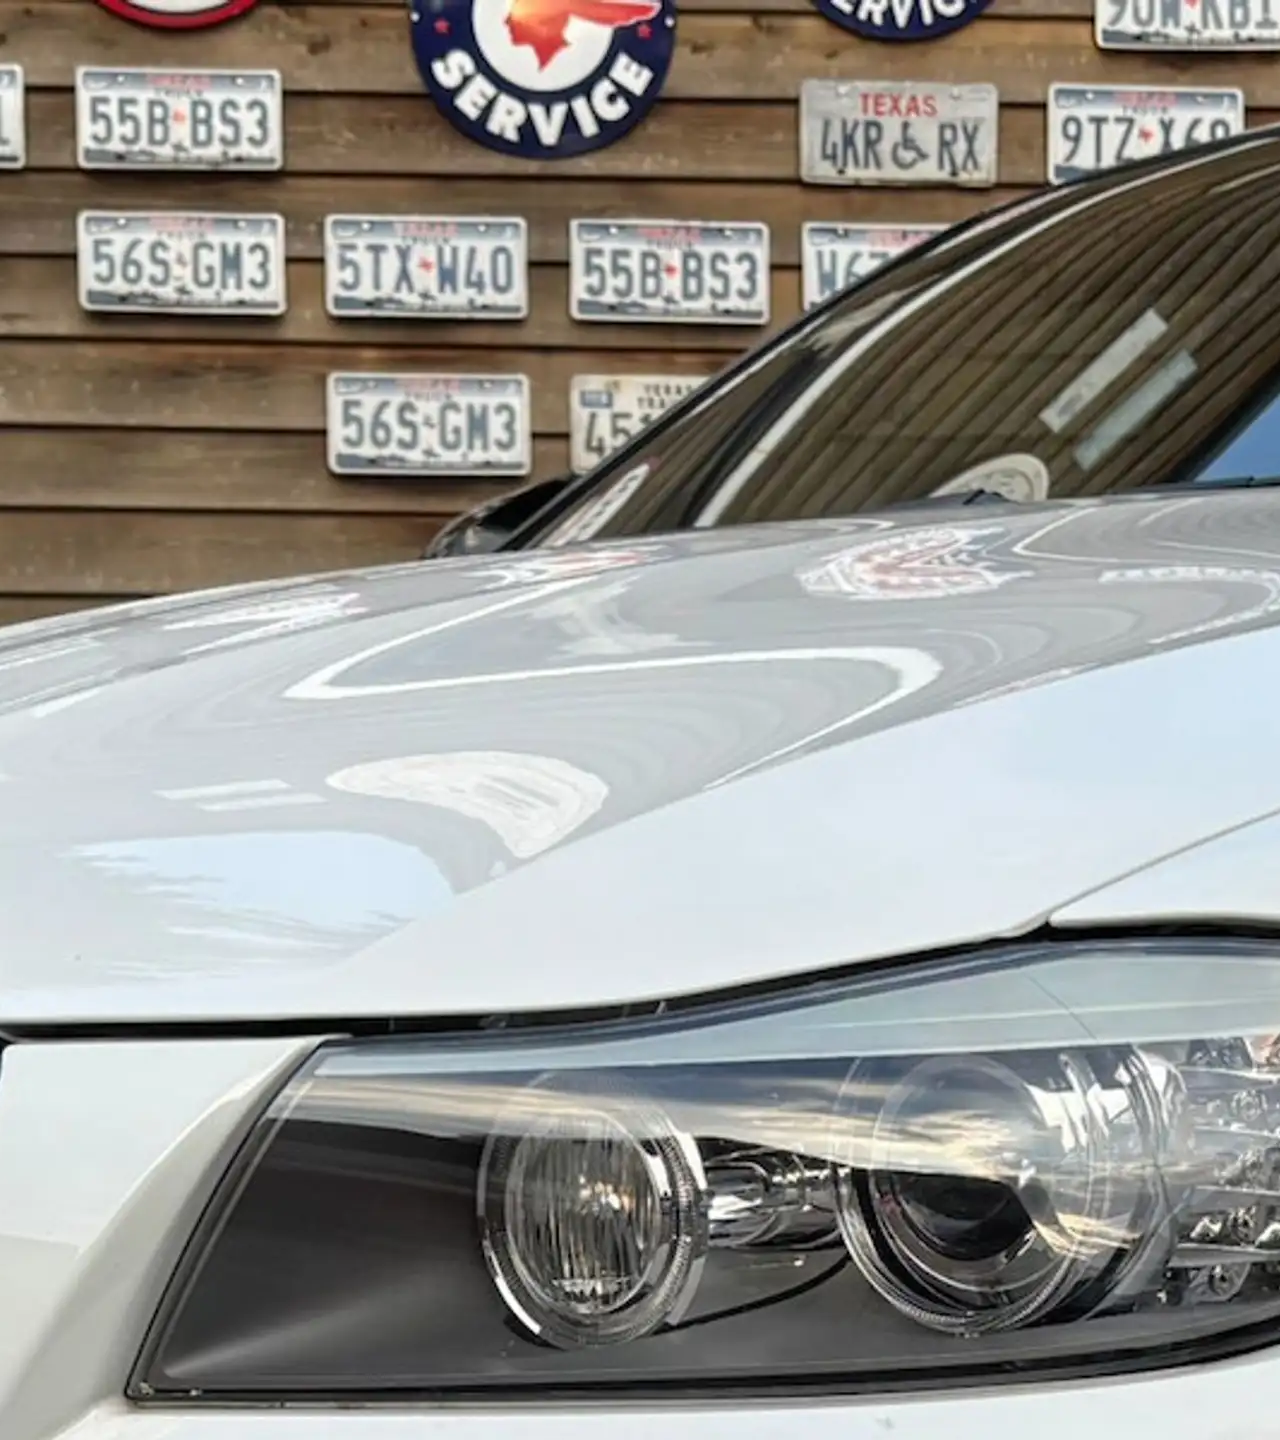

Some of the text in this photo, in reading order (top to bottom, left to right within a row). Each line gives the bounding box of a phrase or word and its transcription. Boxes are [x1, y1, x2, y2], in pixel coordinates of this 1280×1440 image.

[89, 95, 269, 149] 55B BS3
[430, 48, 655, 147] SERVICE
[859, 92, 939, 117] TEXAS
[822, 117, 981, 173] 4KR RX
[92, 237, 270, 291] 56S GM3
[337, 242, 514, 295] 5TX W40
[584, 246, 758, 301] 55B BS3
[341, 398, 517, 453] 56S GM3
